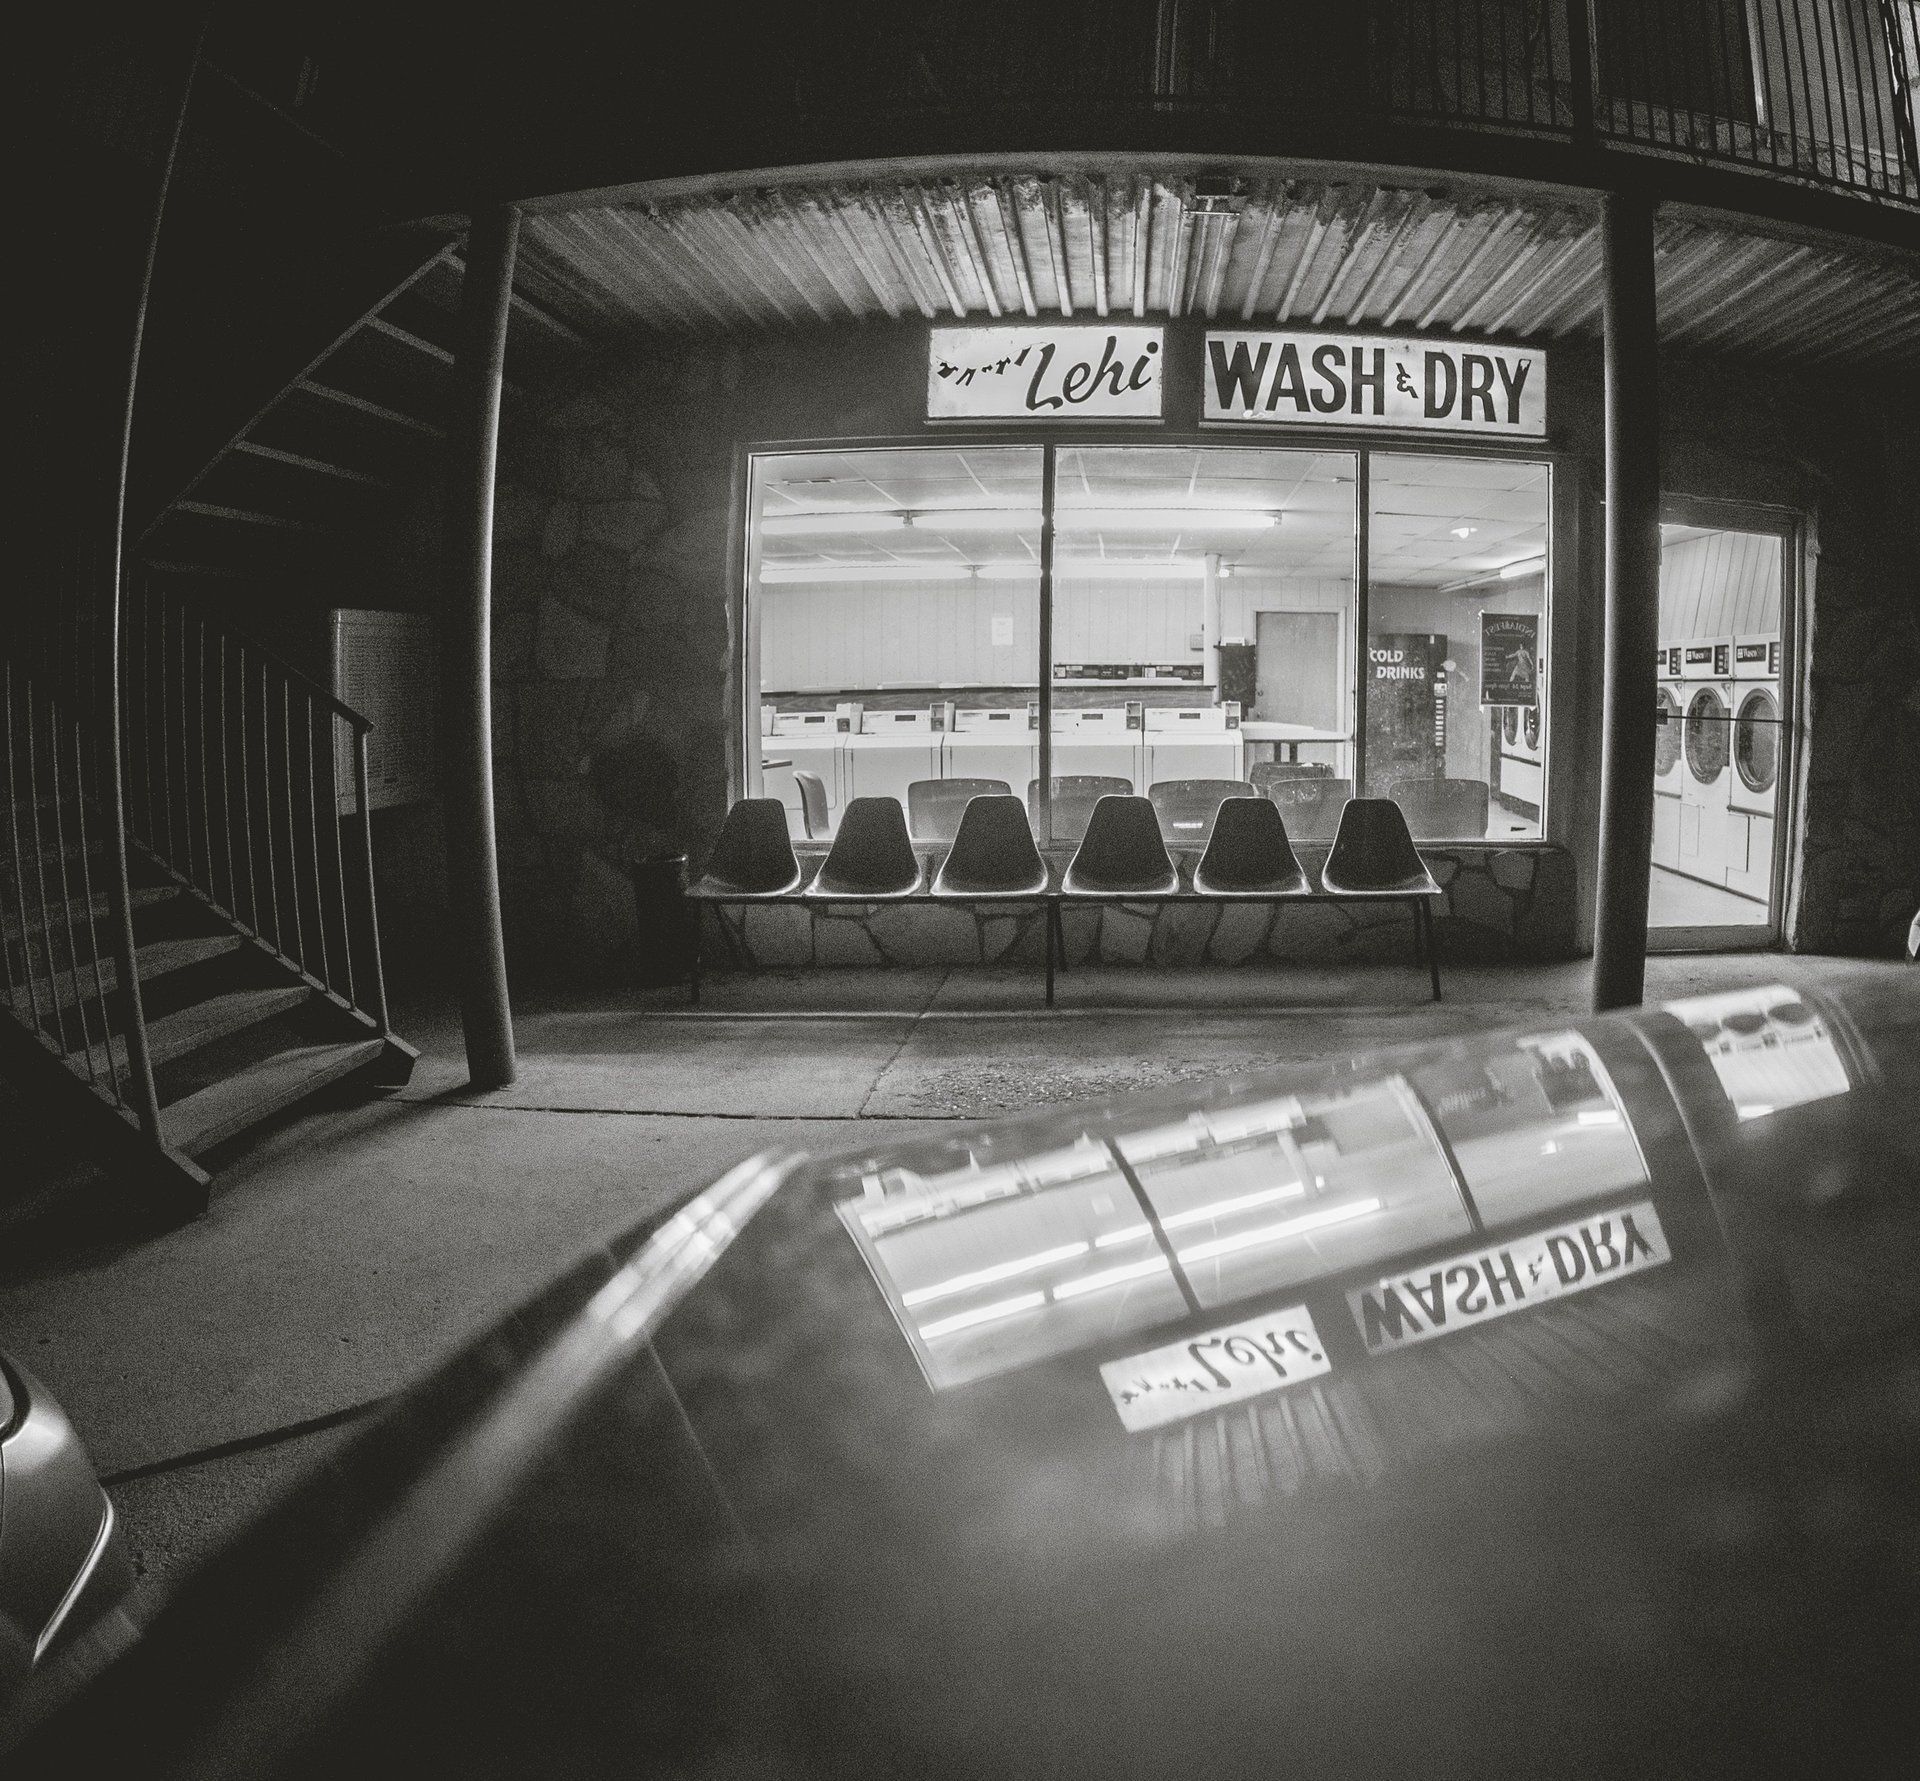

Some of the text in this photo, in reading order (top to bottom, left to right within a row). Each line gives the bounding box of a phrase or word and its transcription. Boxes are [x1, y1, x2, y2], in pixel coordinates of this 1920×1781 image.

[1026, 335, 1159, 411] Lehi
[1208, 340, 1532, 424] WASH & DRY
[1370, 649, 1403, 663] COLD
[1376, 666, 1425, 680] DRINKS
